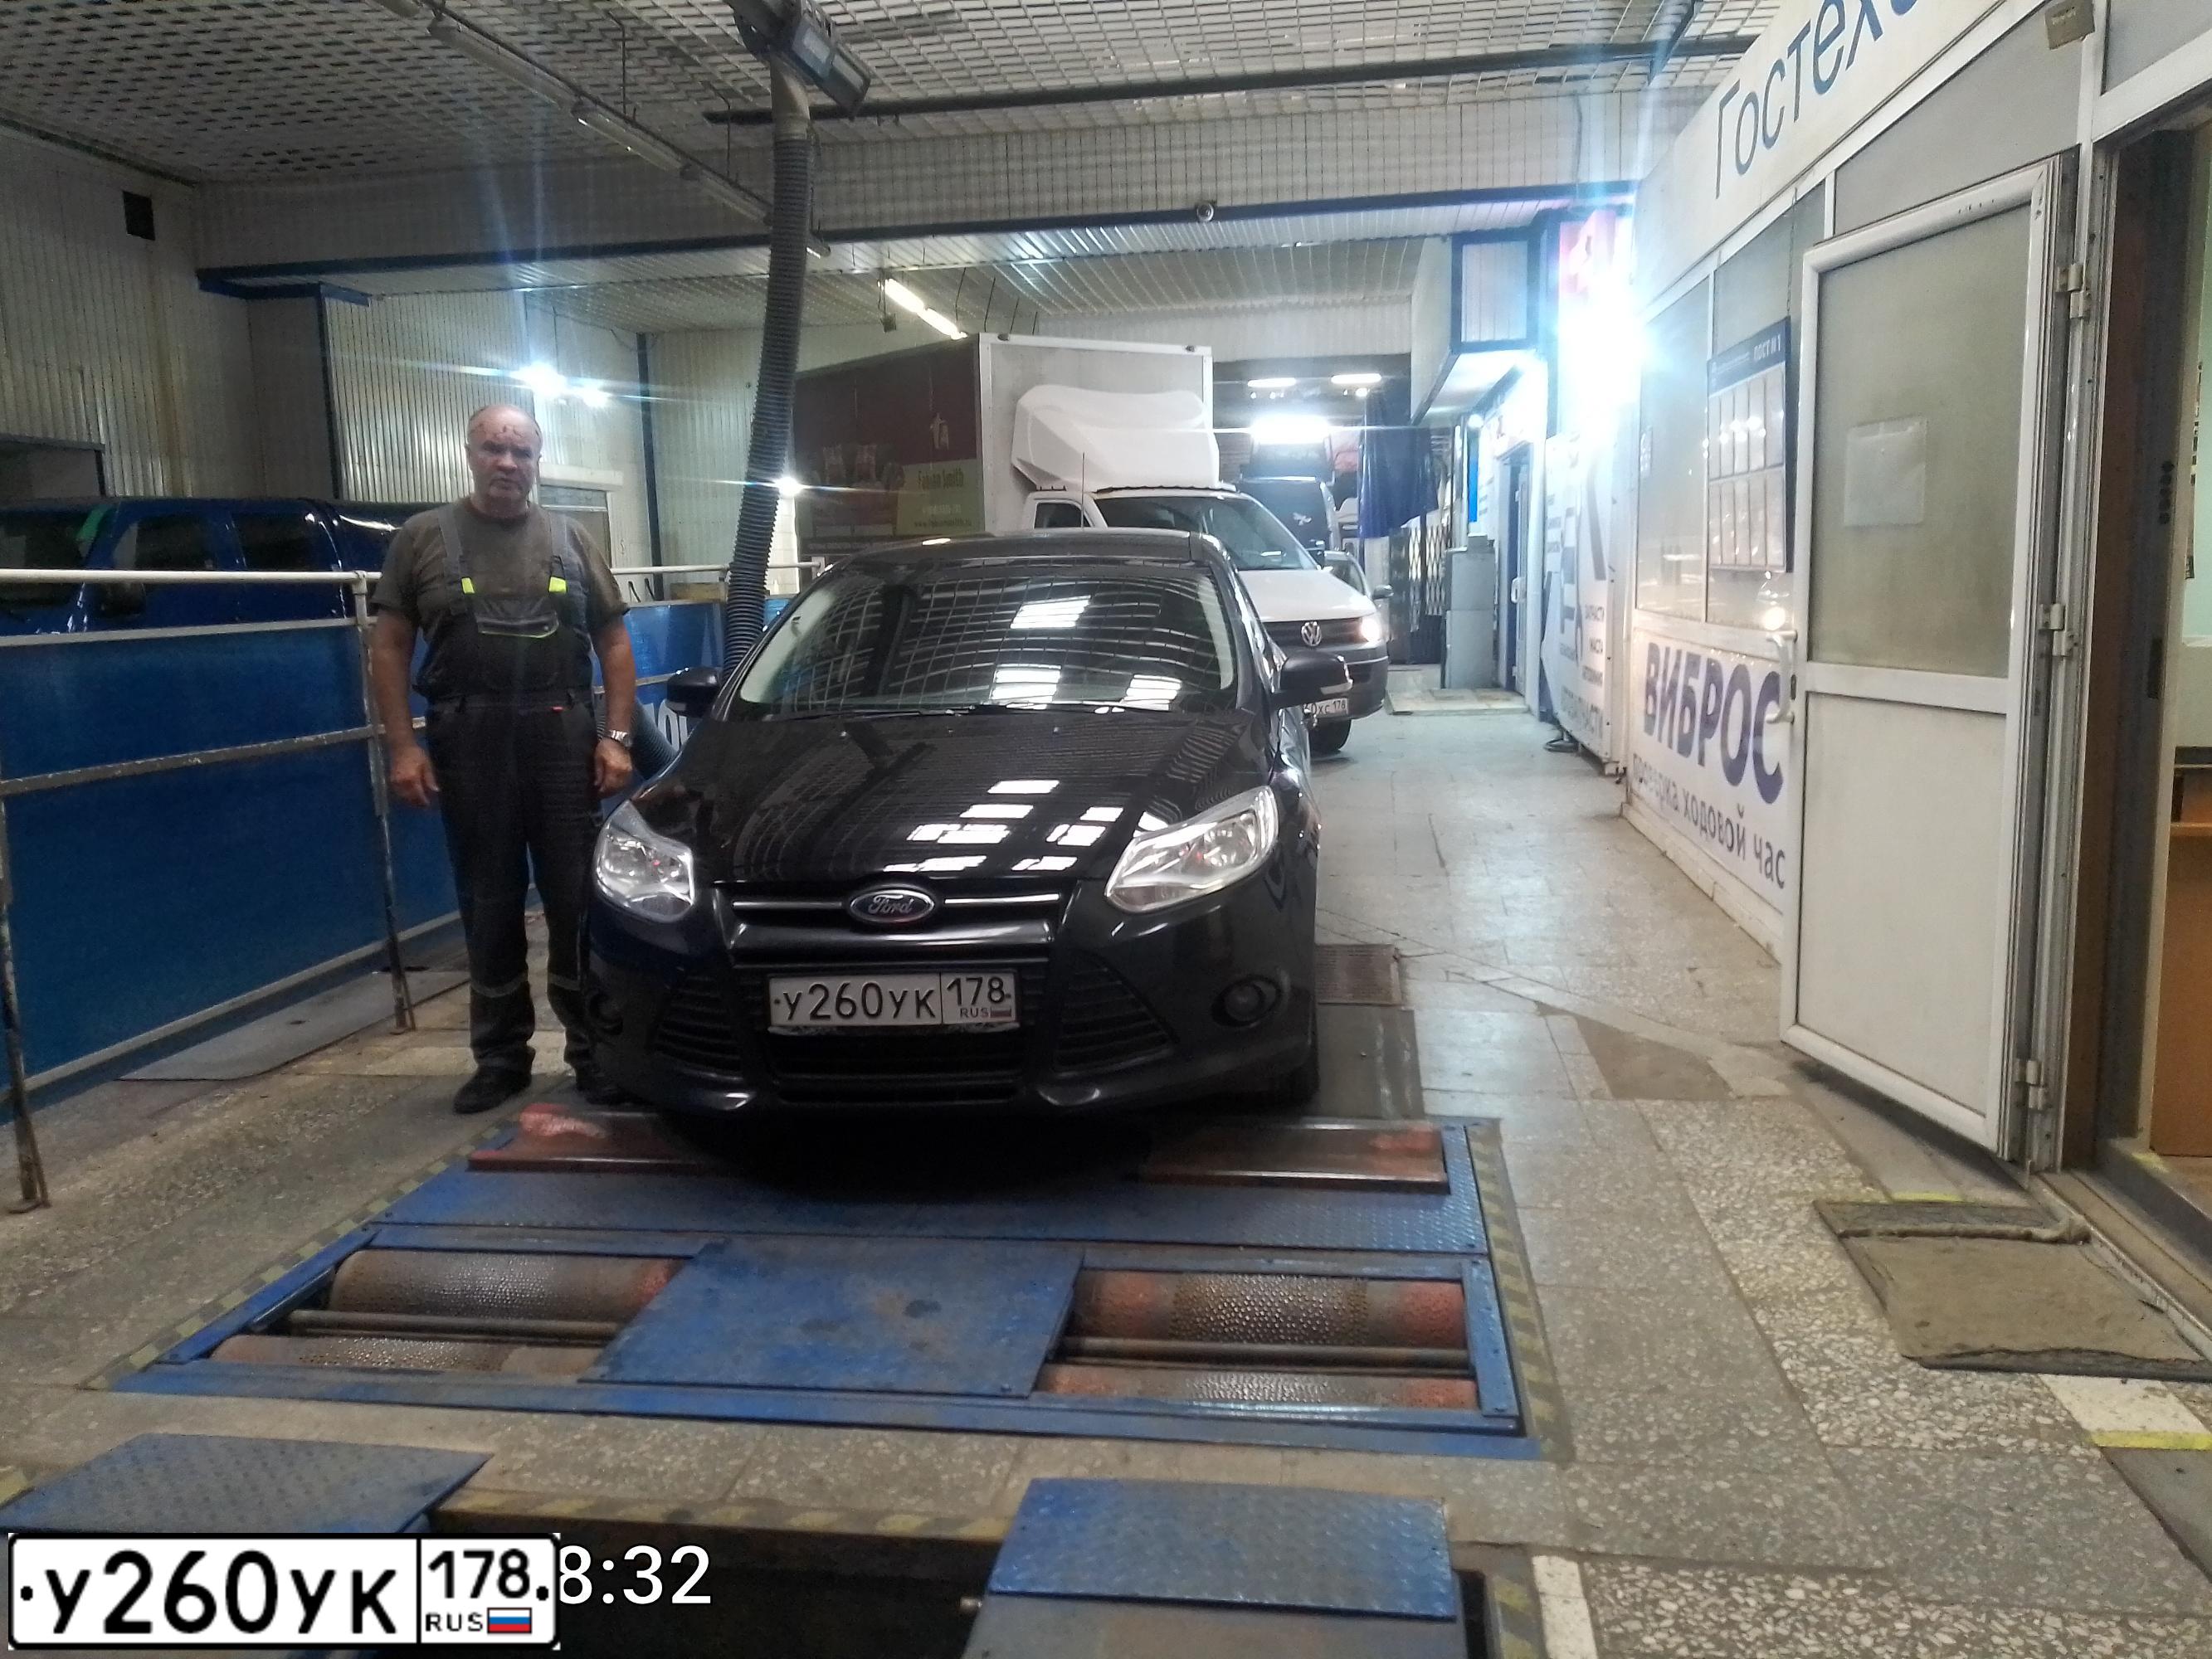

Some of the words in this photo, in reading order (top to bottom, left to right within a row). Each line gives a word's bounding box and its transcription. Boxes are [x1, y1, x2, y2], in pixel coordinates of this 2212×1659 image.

[1714, 0, 1916, 199] Гостех
[1682, 788, 1747, 861] ходовой
[868, 893, 914, 916] Ford
[946, 976, 1006, 1006] 178
[959, 1007, 990, 1019] RUS
